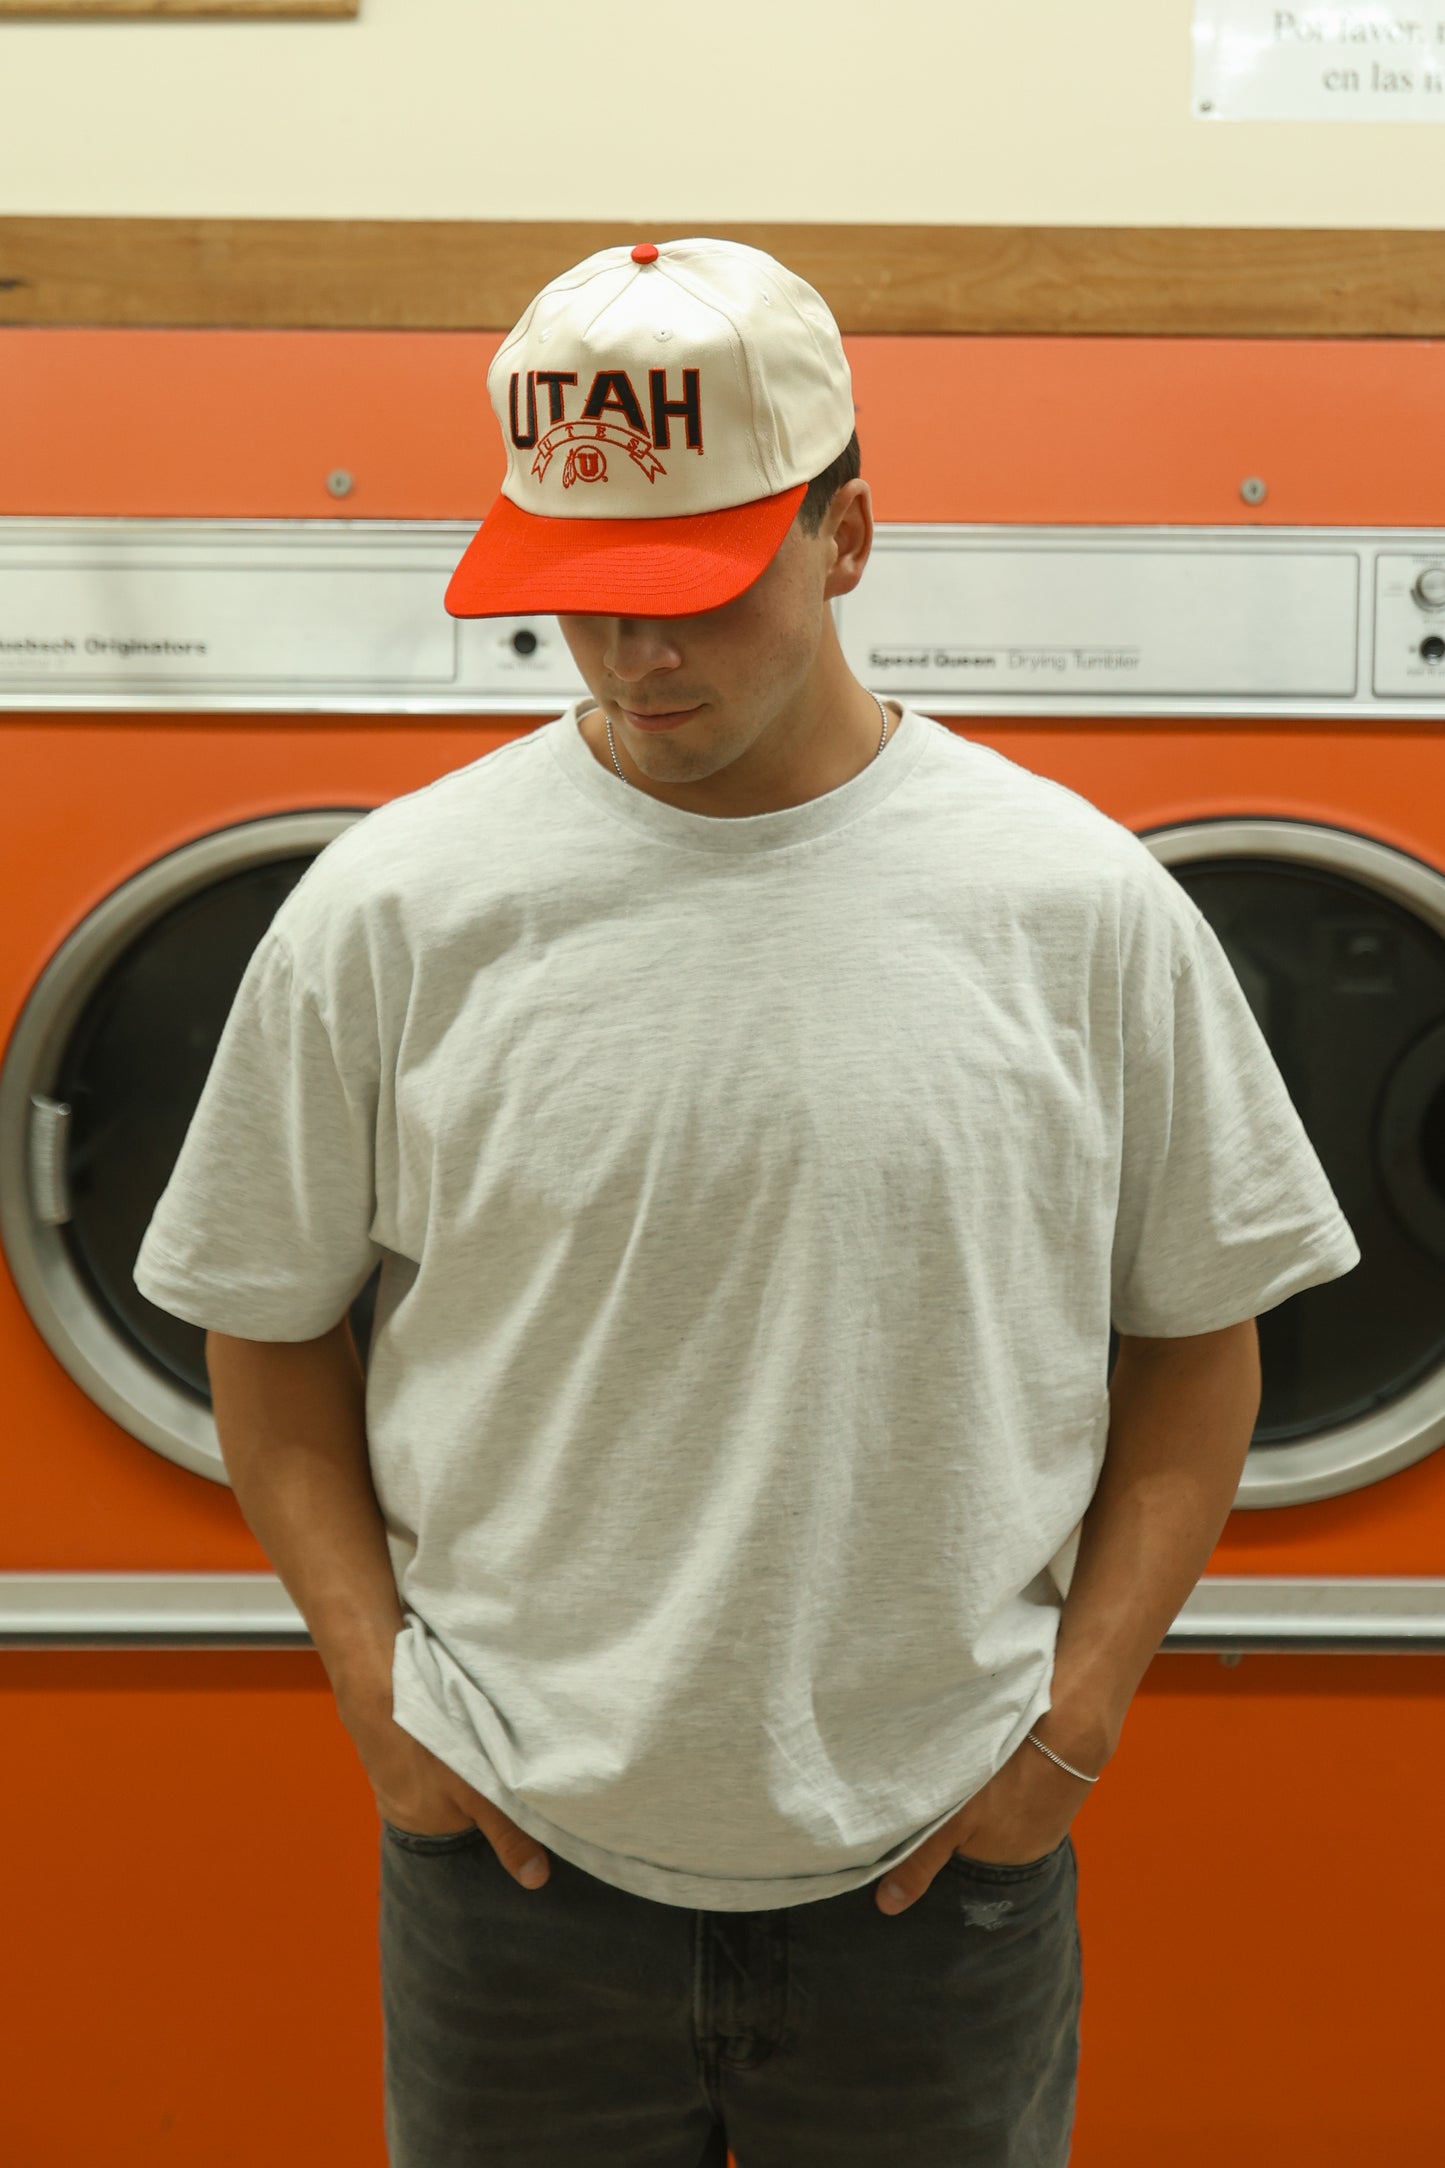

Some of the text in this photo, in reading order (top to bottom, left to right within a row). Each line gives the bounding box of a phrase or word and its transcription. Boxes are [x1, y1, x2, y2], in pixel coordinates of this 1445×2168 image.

[1321, 66, 1360, 93] en
[1371, 59, 1414, 93] las
[508, 368, 702, 449] UTAH
[542, 424, 641, 451] UTES
[577, 452, 599, 477] U
[84, 633, 207, 659] Originators
[869, 650, 1140, 672] Speed Queen Drying Tumbler
